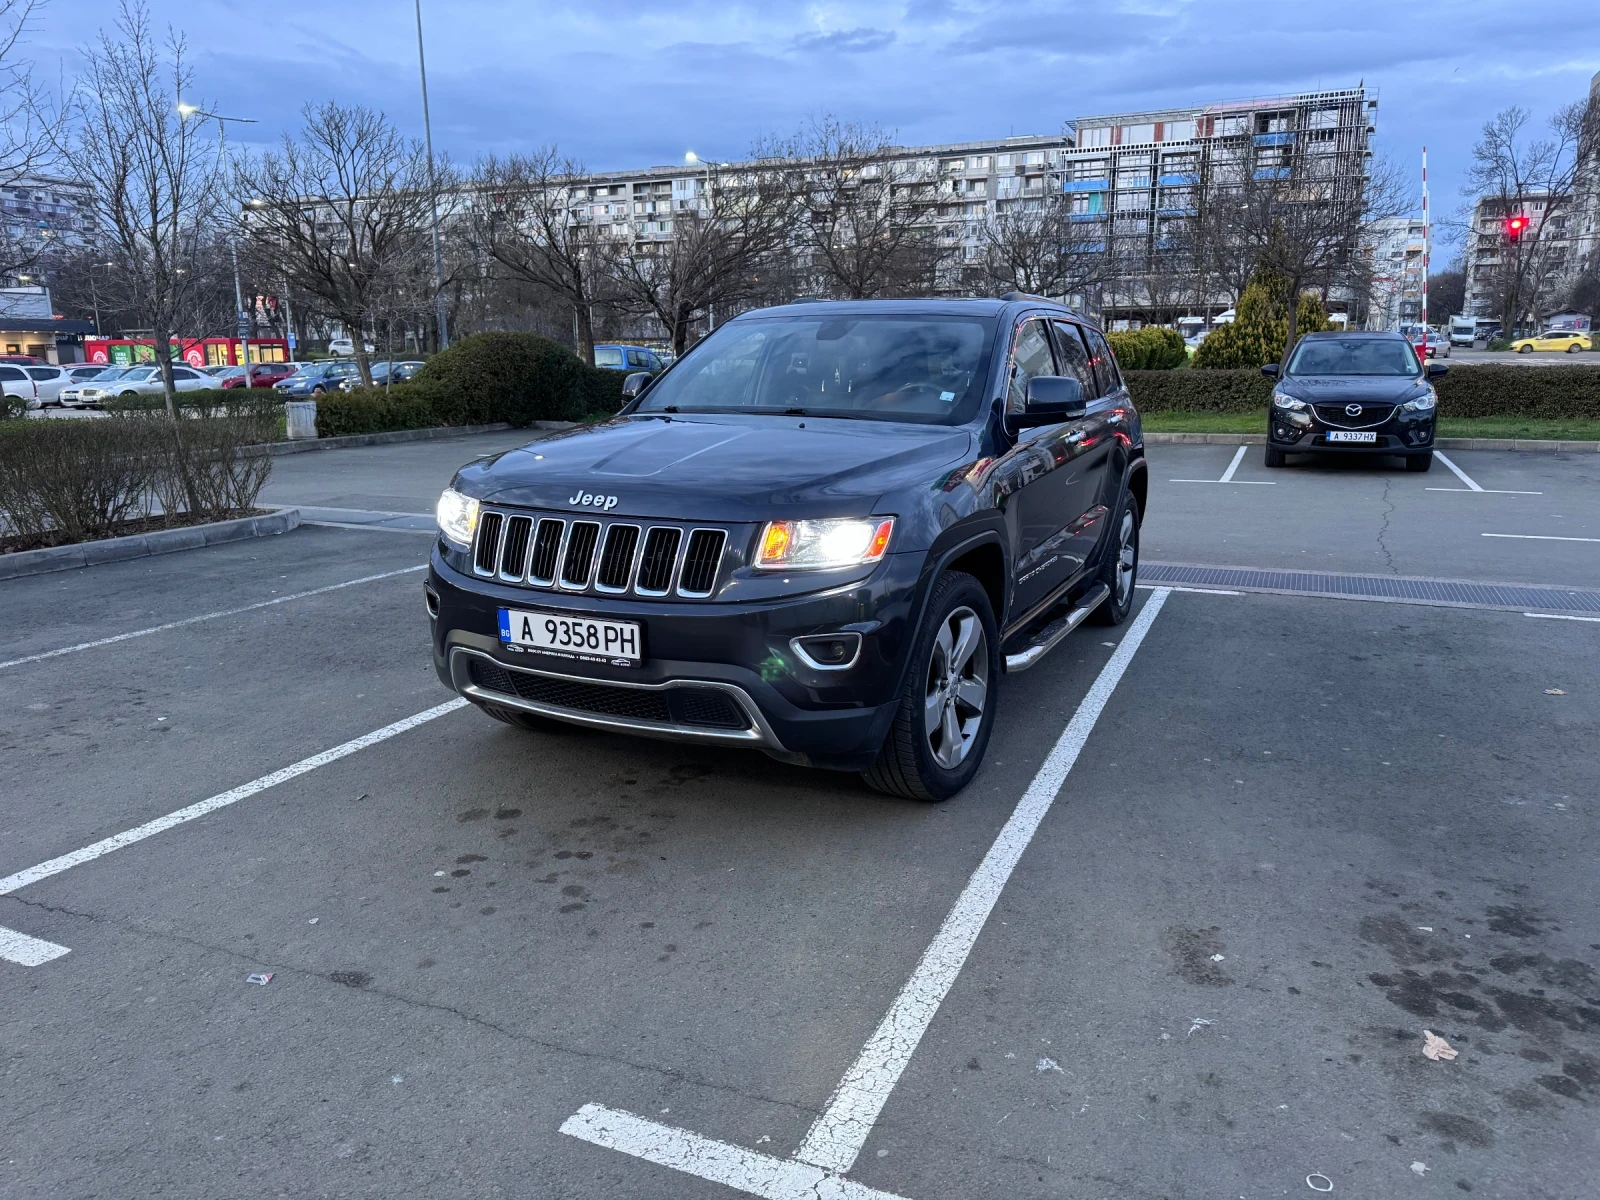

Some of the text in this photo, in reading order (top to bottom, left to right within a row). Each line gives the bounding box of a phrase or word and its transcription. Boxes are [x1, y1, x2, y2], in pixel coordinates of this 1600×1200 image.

[569, 490, 618, 511] Jeep
[501, 628, 510, 638] BG
[521, 616, 636, 654] A 9358 PH
